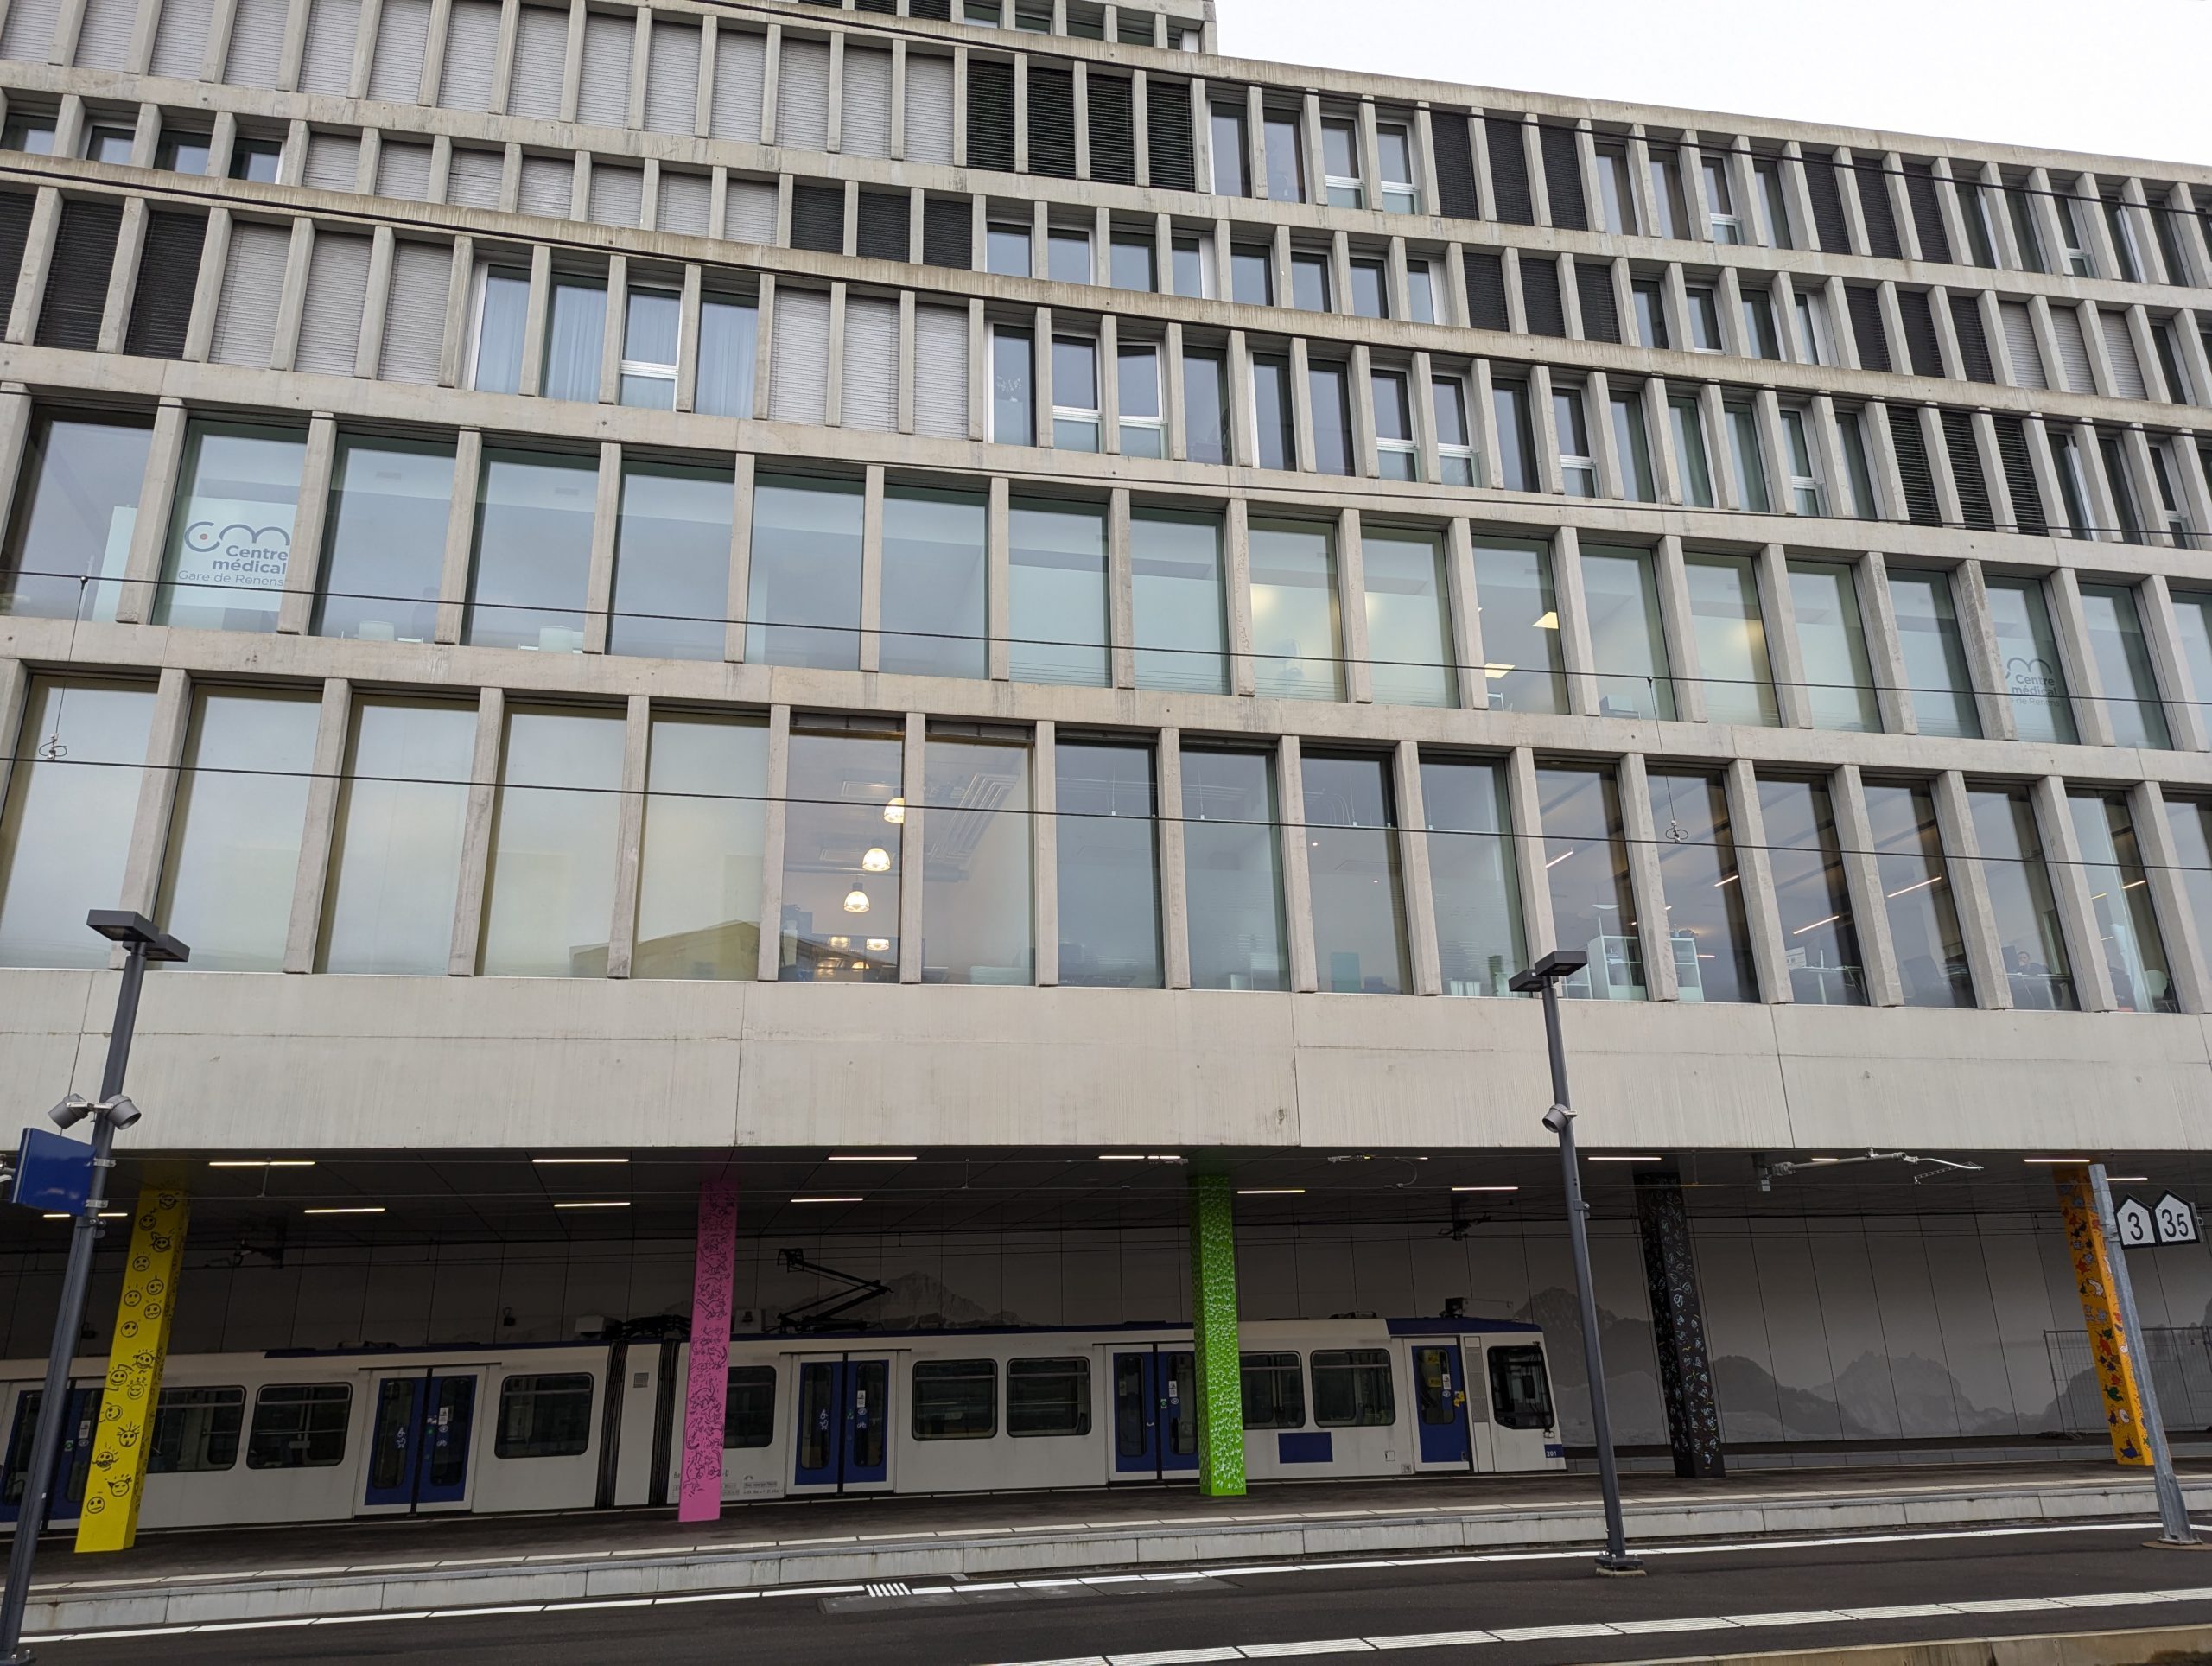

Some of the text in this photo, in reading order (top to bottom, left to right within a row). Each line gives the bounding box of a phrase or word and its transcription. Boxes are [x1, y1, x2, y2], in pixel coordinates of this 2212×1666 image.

[226, 545, 289, 561] Centre
[213, 559, 287, 575] médical
[178, 570, 283, 587] Gare de Renens
[2016, 674, 2055, 686] Centre
[2012, 685, 2057, 697] médical
[2128, 1212, 2143, 1241] 3
[2162, 1209, 2189, 1237] 35
